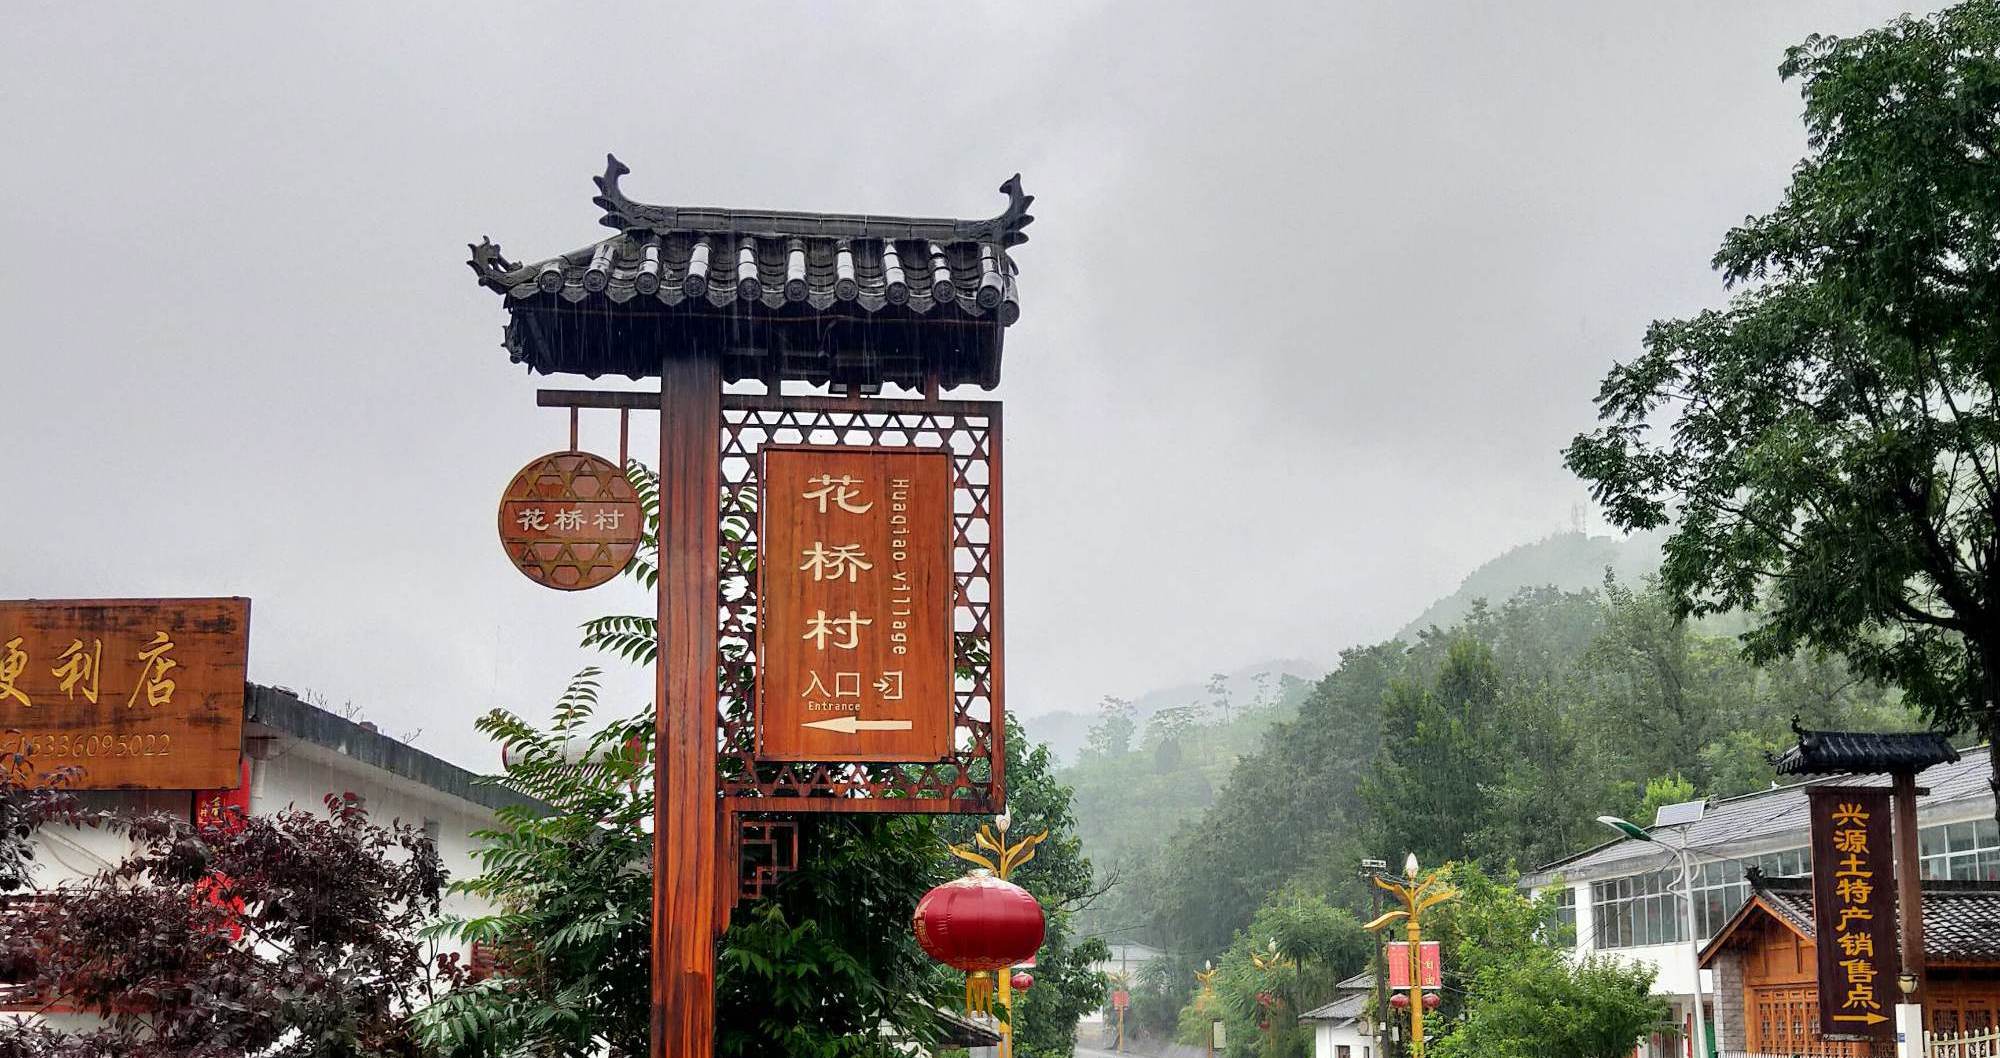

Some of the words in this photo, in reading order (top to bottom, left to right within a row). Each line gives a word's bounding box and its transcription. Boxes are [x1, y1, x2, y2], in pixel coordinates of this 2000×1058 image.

[516, 507, 625, 532] 花桥村
[891, 479, 911, 561] Huaqiao
[801, 474, 873, 650] 花桥村
[892, 571, 911, 656] village
[801, 670, 861, 698] 入口
[808, 700, 861, 712] Entrance
[1831, 803, 1881, 1009] 兴源土特产销售点
